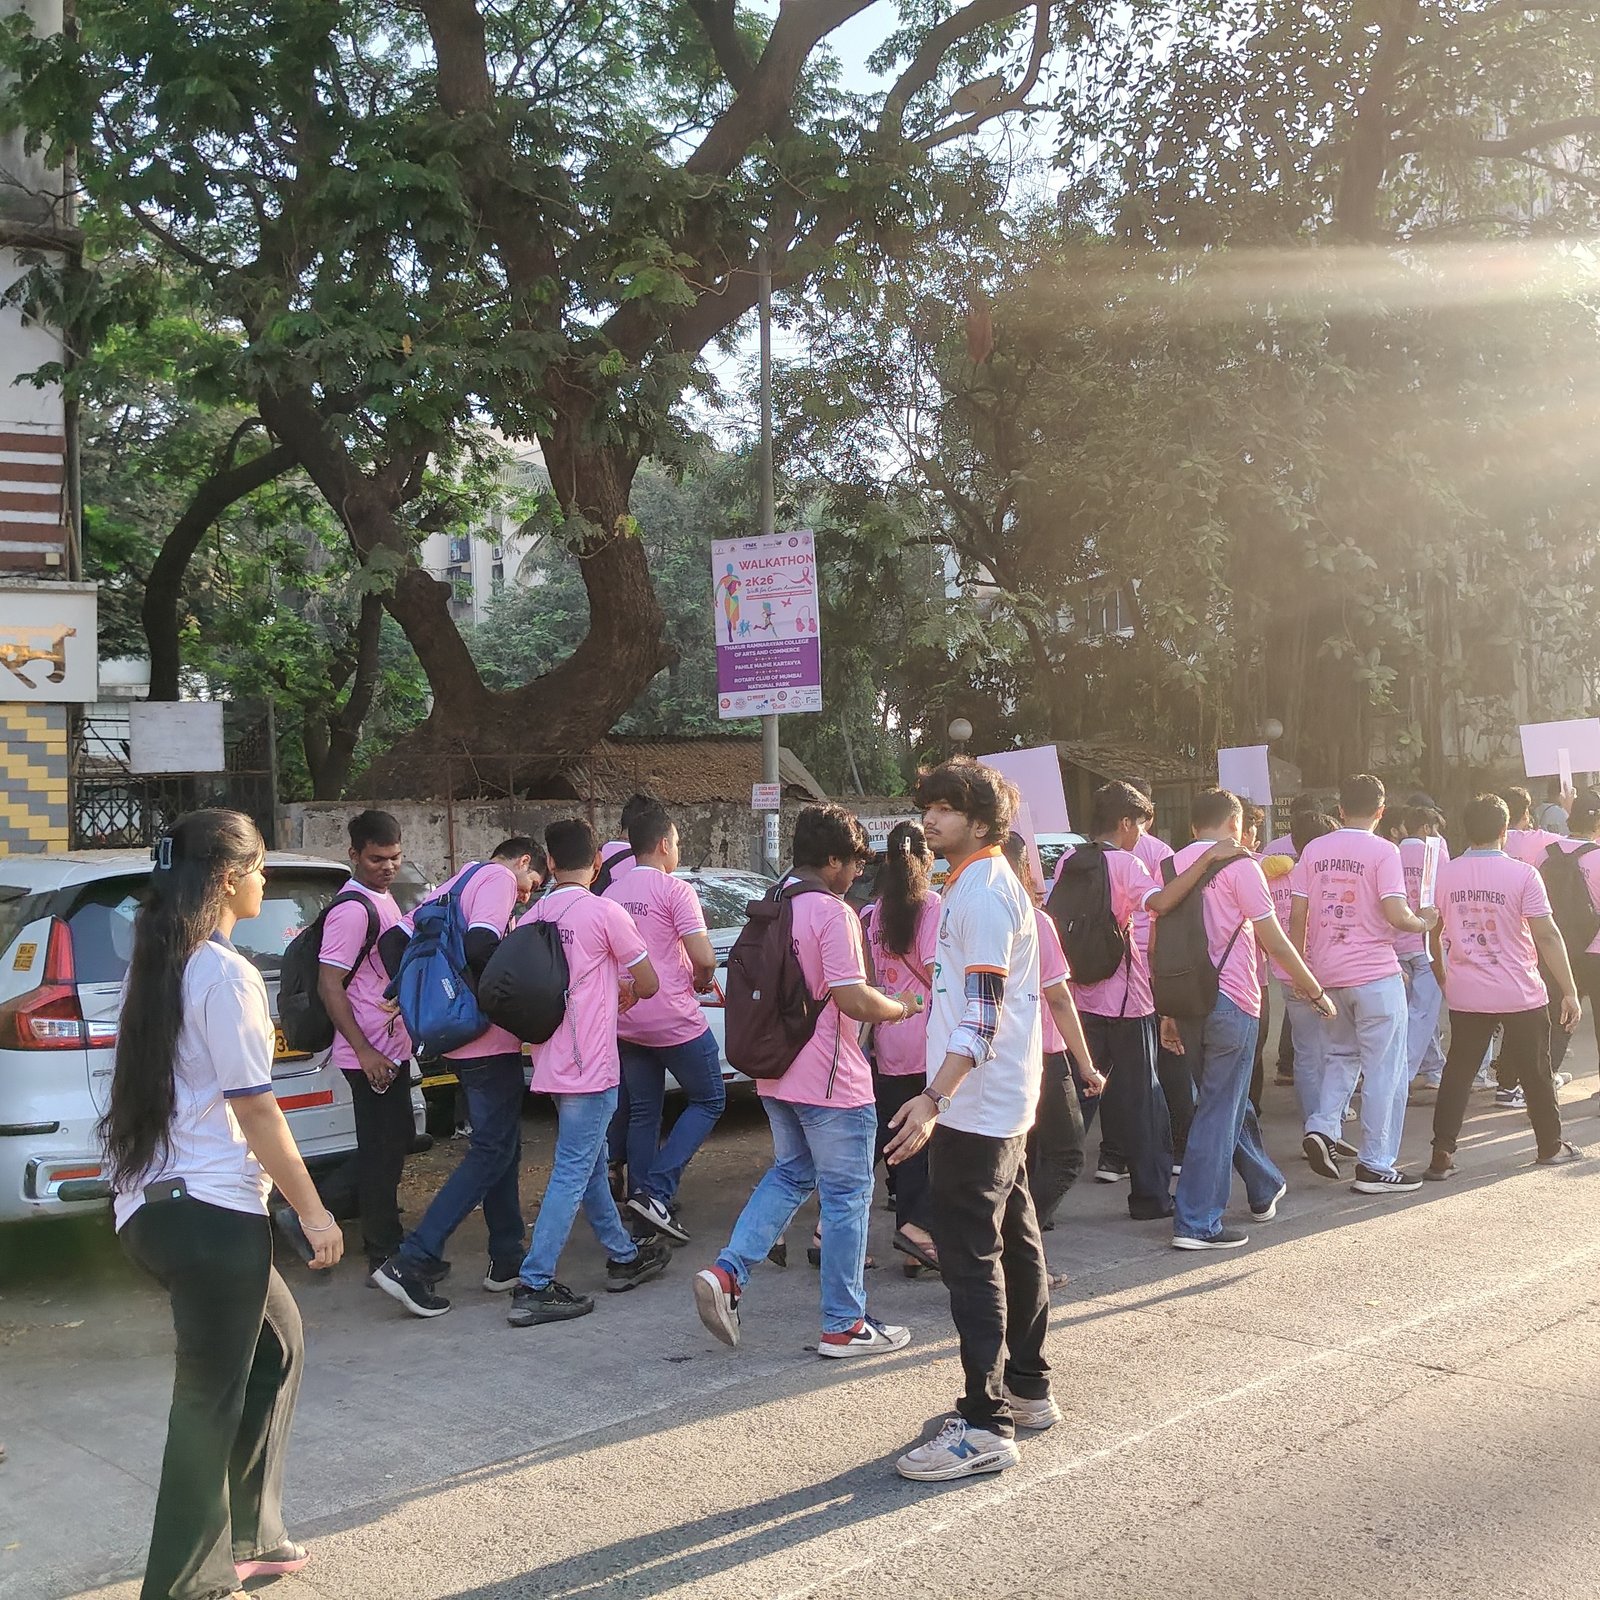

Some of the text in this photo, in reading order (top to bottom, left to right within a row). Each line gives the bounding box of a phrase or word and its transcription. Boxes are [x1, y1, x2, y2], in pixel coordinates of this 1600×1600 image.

[738, 553, 813, 571] WALKATHON
[745, 575, 774, 587] 2K26
[746, 641, 784, 649] RAMNARAYAN
[1314, 858, 1365, 877] OUR PARTNERS
[1450, 889, 1506, 906] OUR PARTNERS
